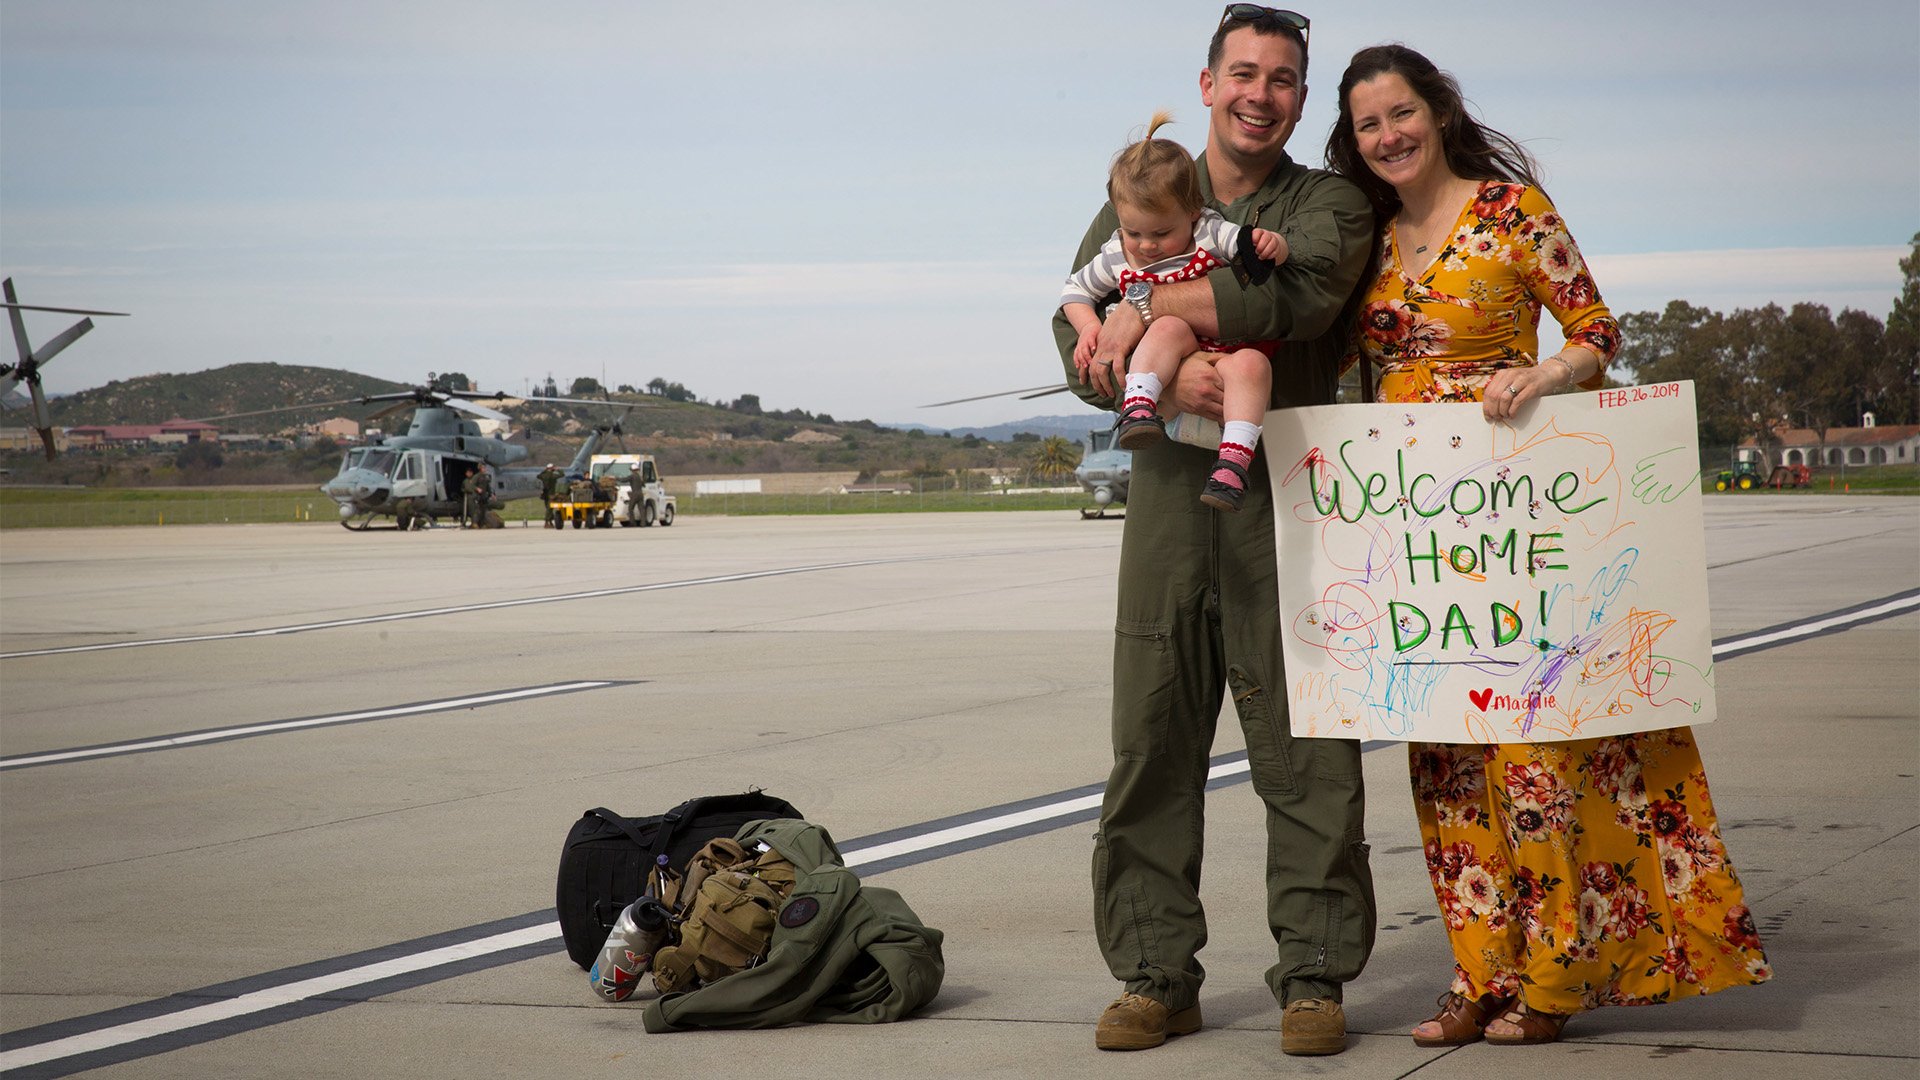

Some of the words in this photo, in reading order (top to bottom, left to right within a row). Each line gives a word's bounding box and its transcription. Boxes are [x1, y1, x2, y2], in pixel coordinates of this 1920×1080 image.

[1310, 440, 1608, 523] Welcome
[1388, 590, 1550, 653] DAD!
[1491, 692, 1556, 711] Maddie
